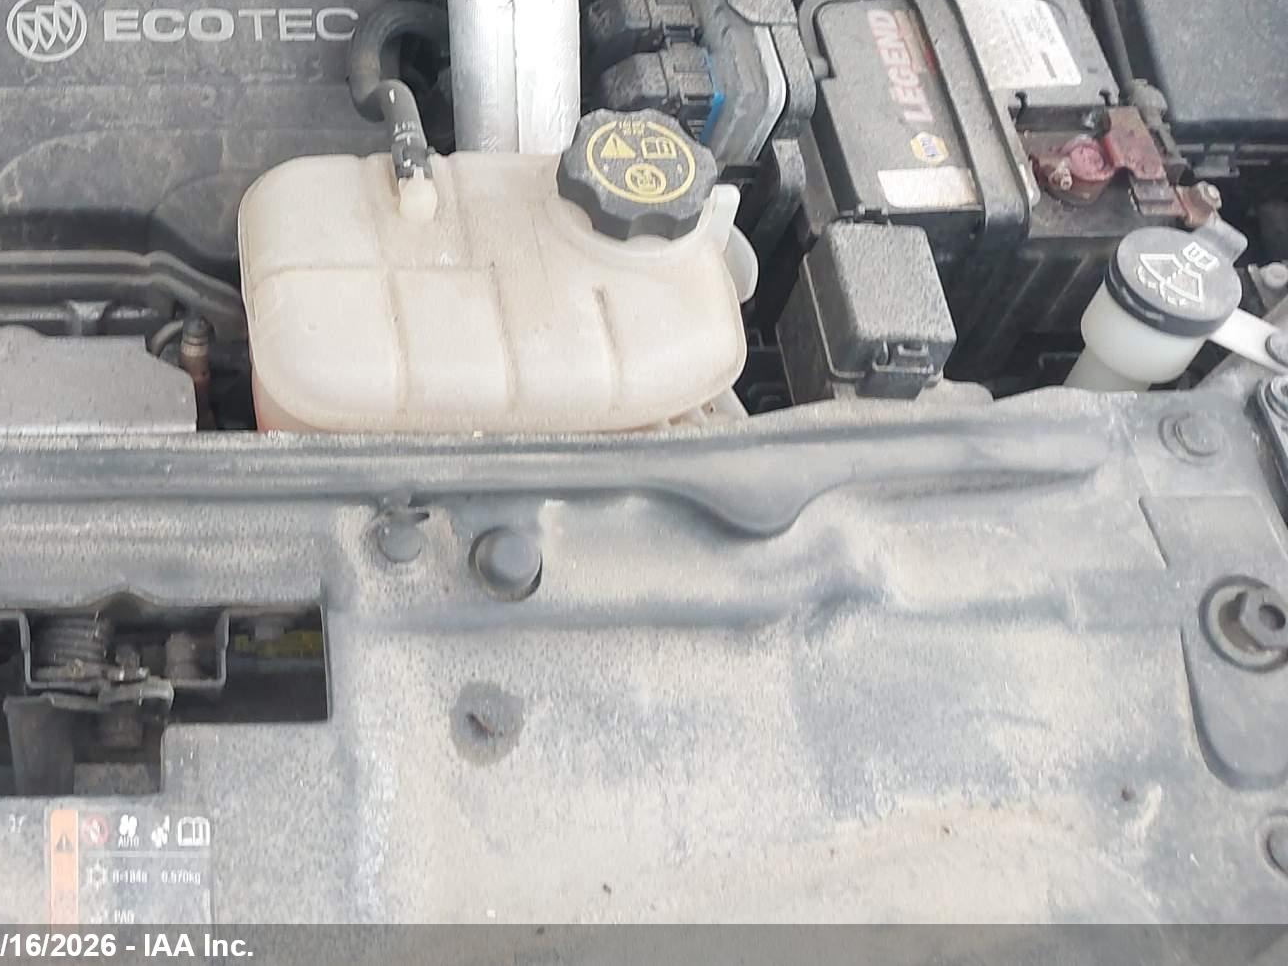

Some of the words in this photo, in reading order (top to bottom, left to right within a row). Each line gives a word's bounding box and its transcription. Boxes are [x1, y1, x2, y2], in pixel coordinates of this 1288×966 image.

[103, 7, 359, 43] ECOTEC
[866, 8, 934, 124] LEGEND
[118, 836, 140, 848] AUTO
